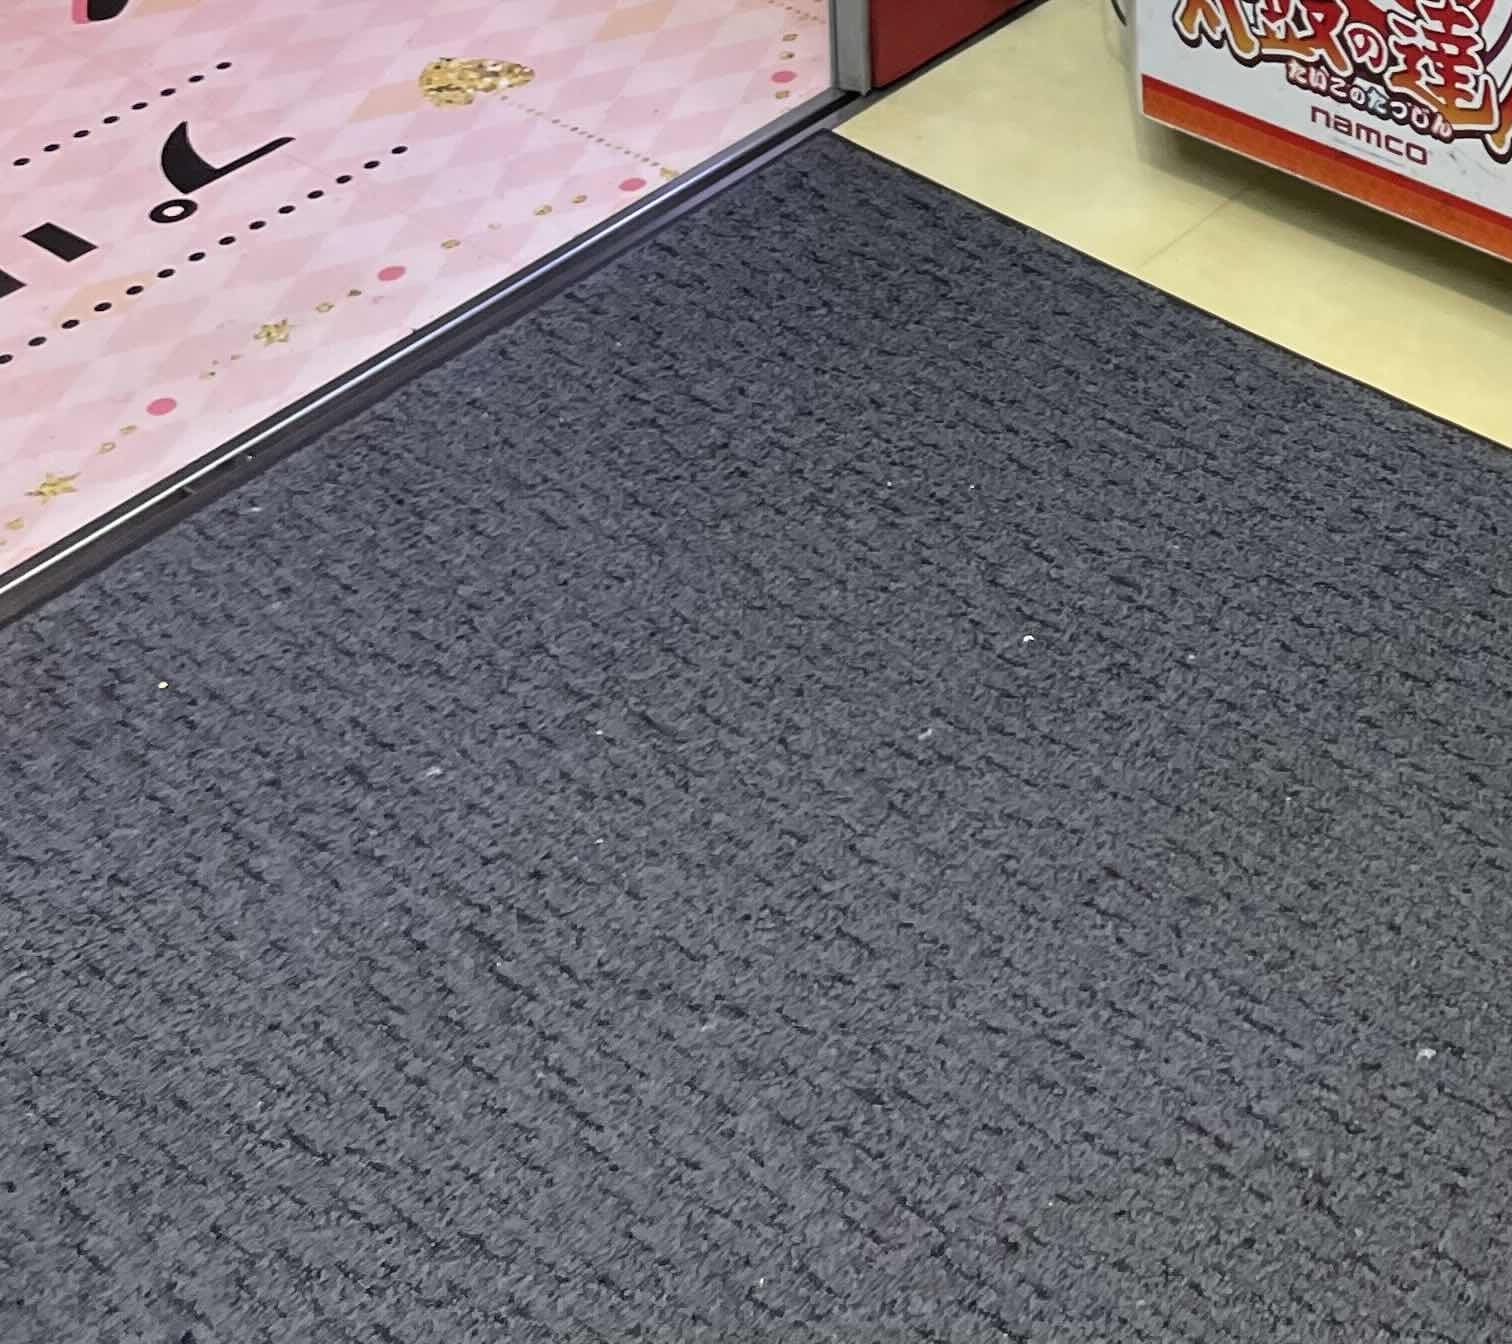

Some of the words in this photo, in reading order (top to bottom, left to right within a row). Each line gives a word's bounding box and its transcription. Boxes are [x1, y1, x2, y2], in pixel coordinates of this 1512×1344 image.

[1285, 56, 1457, 141] たいこのたつじん
[1310, 106, 1431, 167] namco
